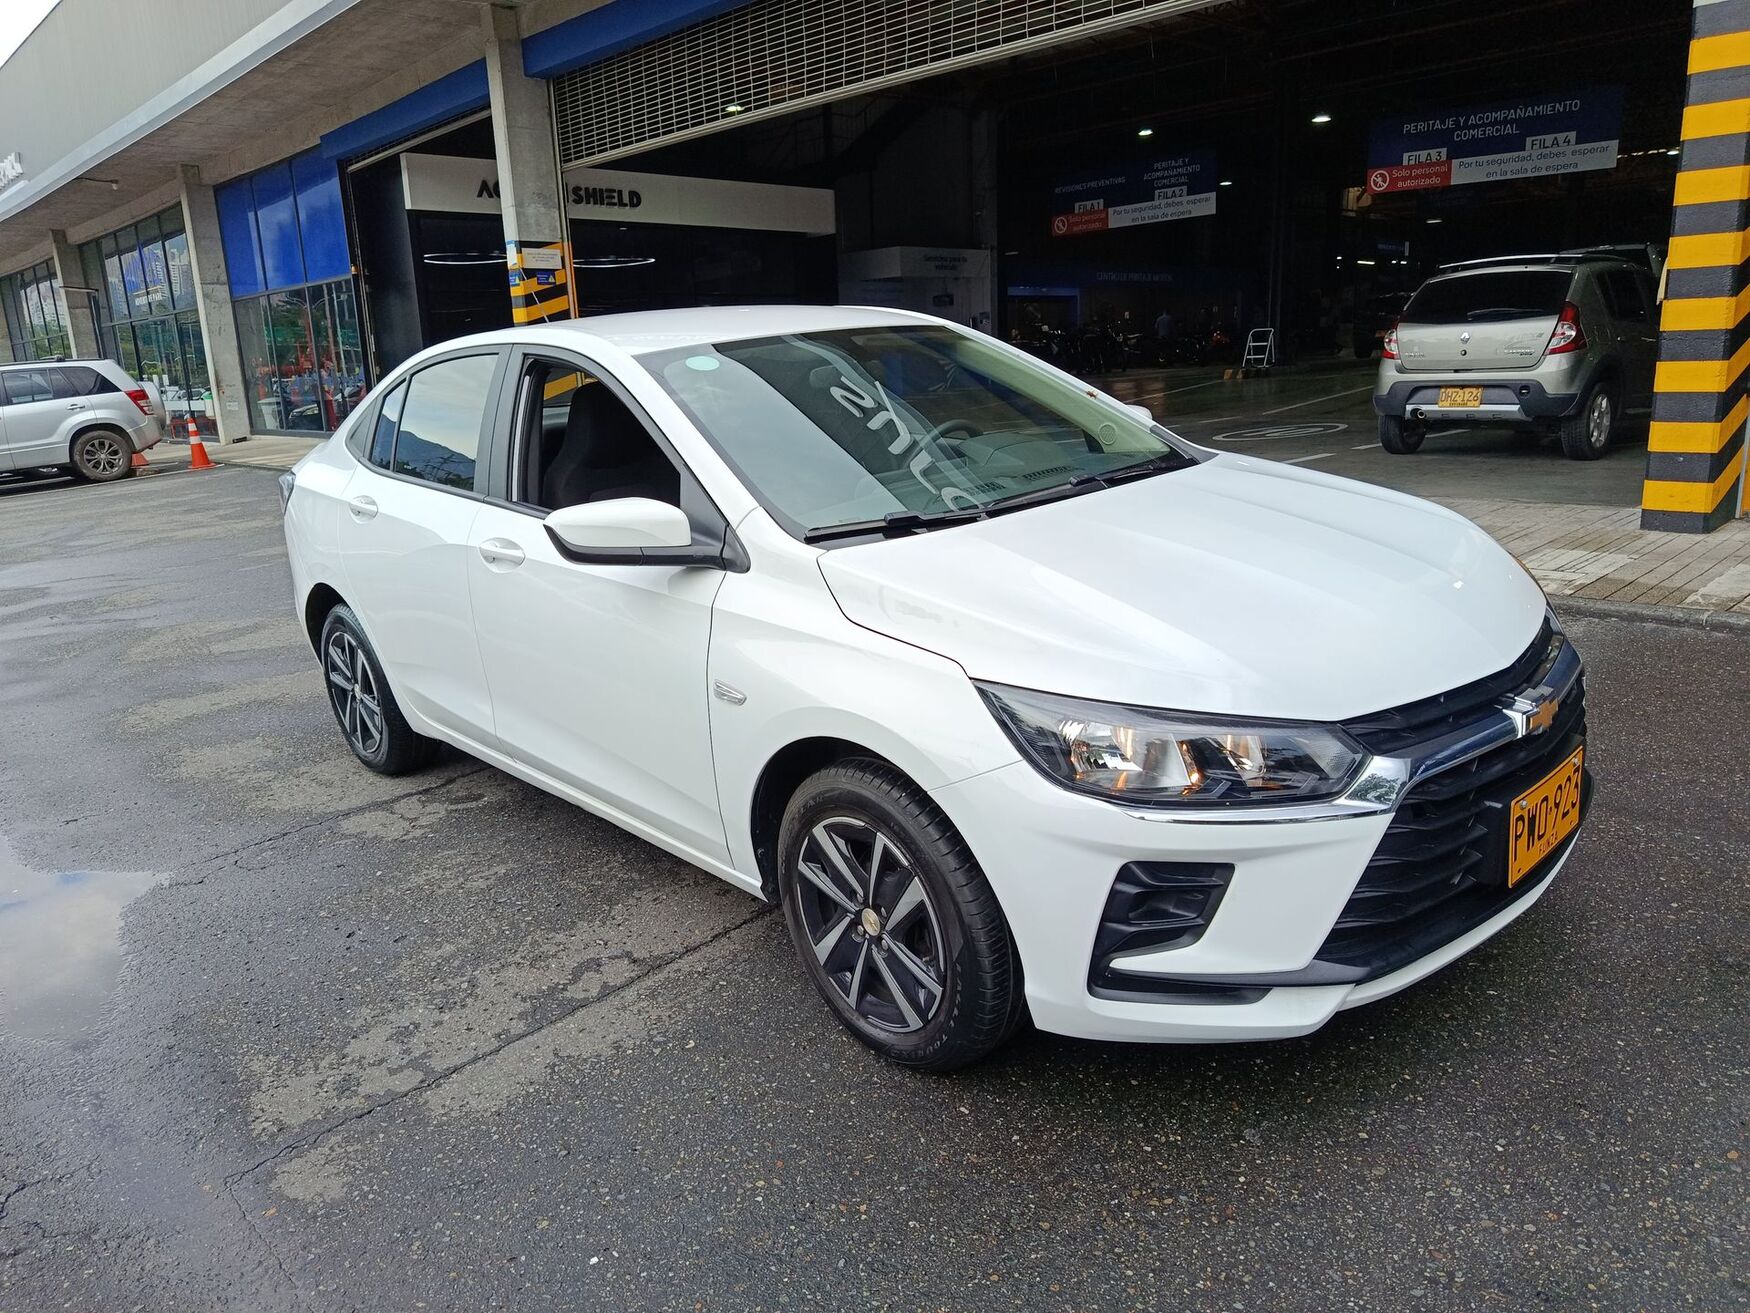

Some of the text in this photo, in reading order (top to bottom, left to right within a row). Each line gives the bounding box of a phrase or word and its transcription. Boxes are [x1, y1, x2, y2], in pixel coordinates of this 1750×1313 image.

[1403, 100, 1580, 134] PERITAJE Y ACOMPAÑAMIENTO
[1454, 123, 1520, 142] COMERCIAL
[1531, 135, 1571, 151] FILA 4
[1153, 159, 1184, 170] PERITAJE
[1408, 151, 1442, 165] FILA 3
[1459, 145, 1610, 169] Por tu seguridad, debes esperar
[1392, 163, 1448, 178] Solo personal
[1486, 162, 1578, 179] en la sala de espera
[1398, 176, 1441, 187] autorizado
[1158, 189, 1184, 200] FILA 2
